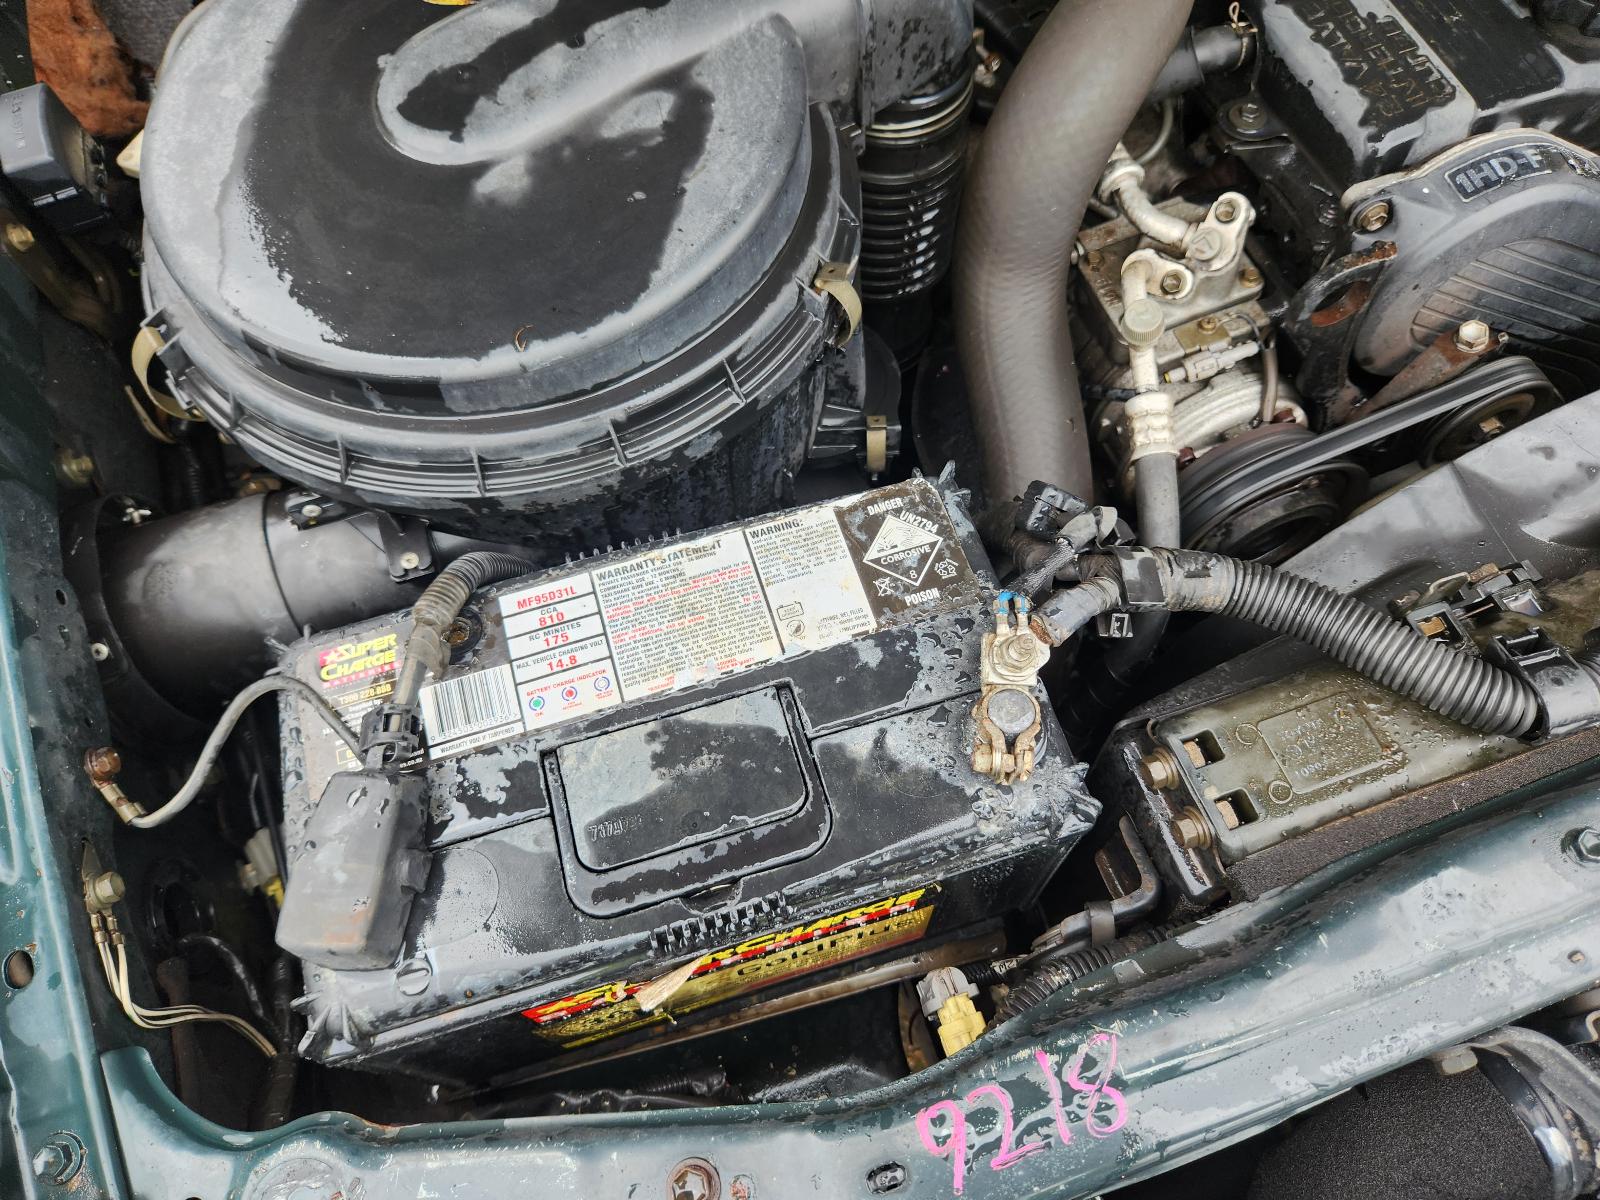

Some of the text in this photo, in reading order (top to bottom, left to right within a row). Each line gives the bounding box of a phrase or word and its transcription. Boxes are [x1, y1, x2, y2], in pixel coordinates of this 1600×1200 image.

[867, 498, 903, 516] DANGER
[749, 518, 803, 539] WARNING:
[899, 511, 939, 534] UN2794
[596, 540, 722, 581] WARRANTY STATEMENT
[880, 545, 931, 565] CORROSIVE
[599, 580, 633, 592] COMMERCIAL
[658, 567, 679, 576] MONTHS
[909, 569, 918, 579] 8
[517, 586, 576, 609] MF95D31L
[905, 588, 940, 606] POISON
[539, 612, 564, 626] 810
[540, 607, 557, 615] CCA
[529, 622, 581, 641] RC MINUTES
[543, 633, 569, 646] 175
[338, 633, 398, 659] SUPER
[533, 654, 556, 664] VEHICLE
[558, 644, 588, 656] CHARGING
[320, 648, 397, 681] CHARGE
[547, 655, 577, 671] 14.8
[526, 669, 606, 696] BATTERY CHARGE INDICATOR
[440, 741, 467, 752] WARRANTY
[488, 727, 514, 738] TAMPERED
[735, 888, 925, 954] CHARGE
[916, 1033, 1128, 1195] 9218
